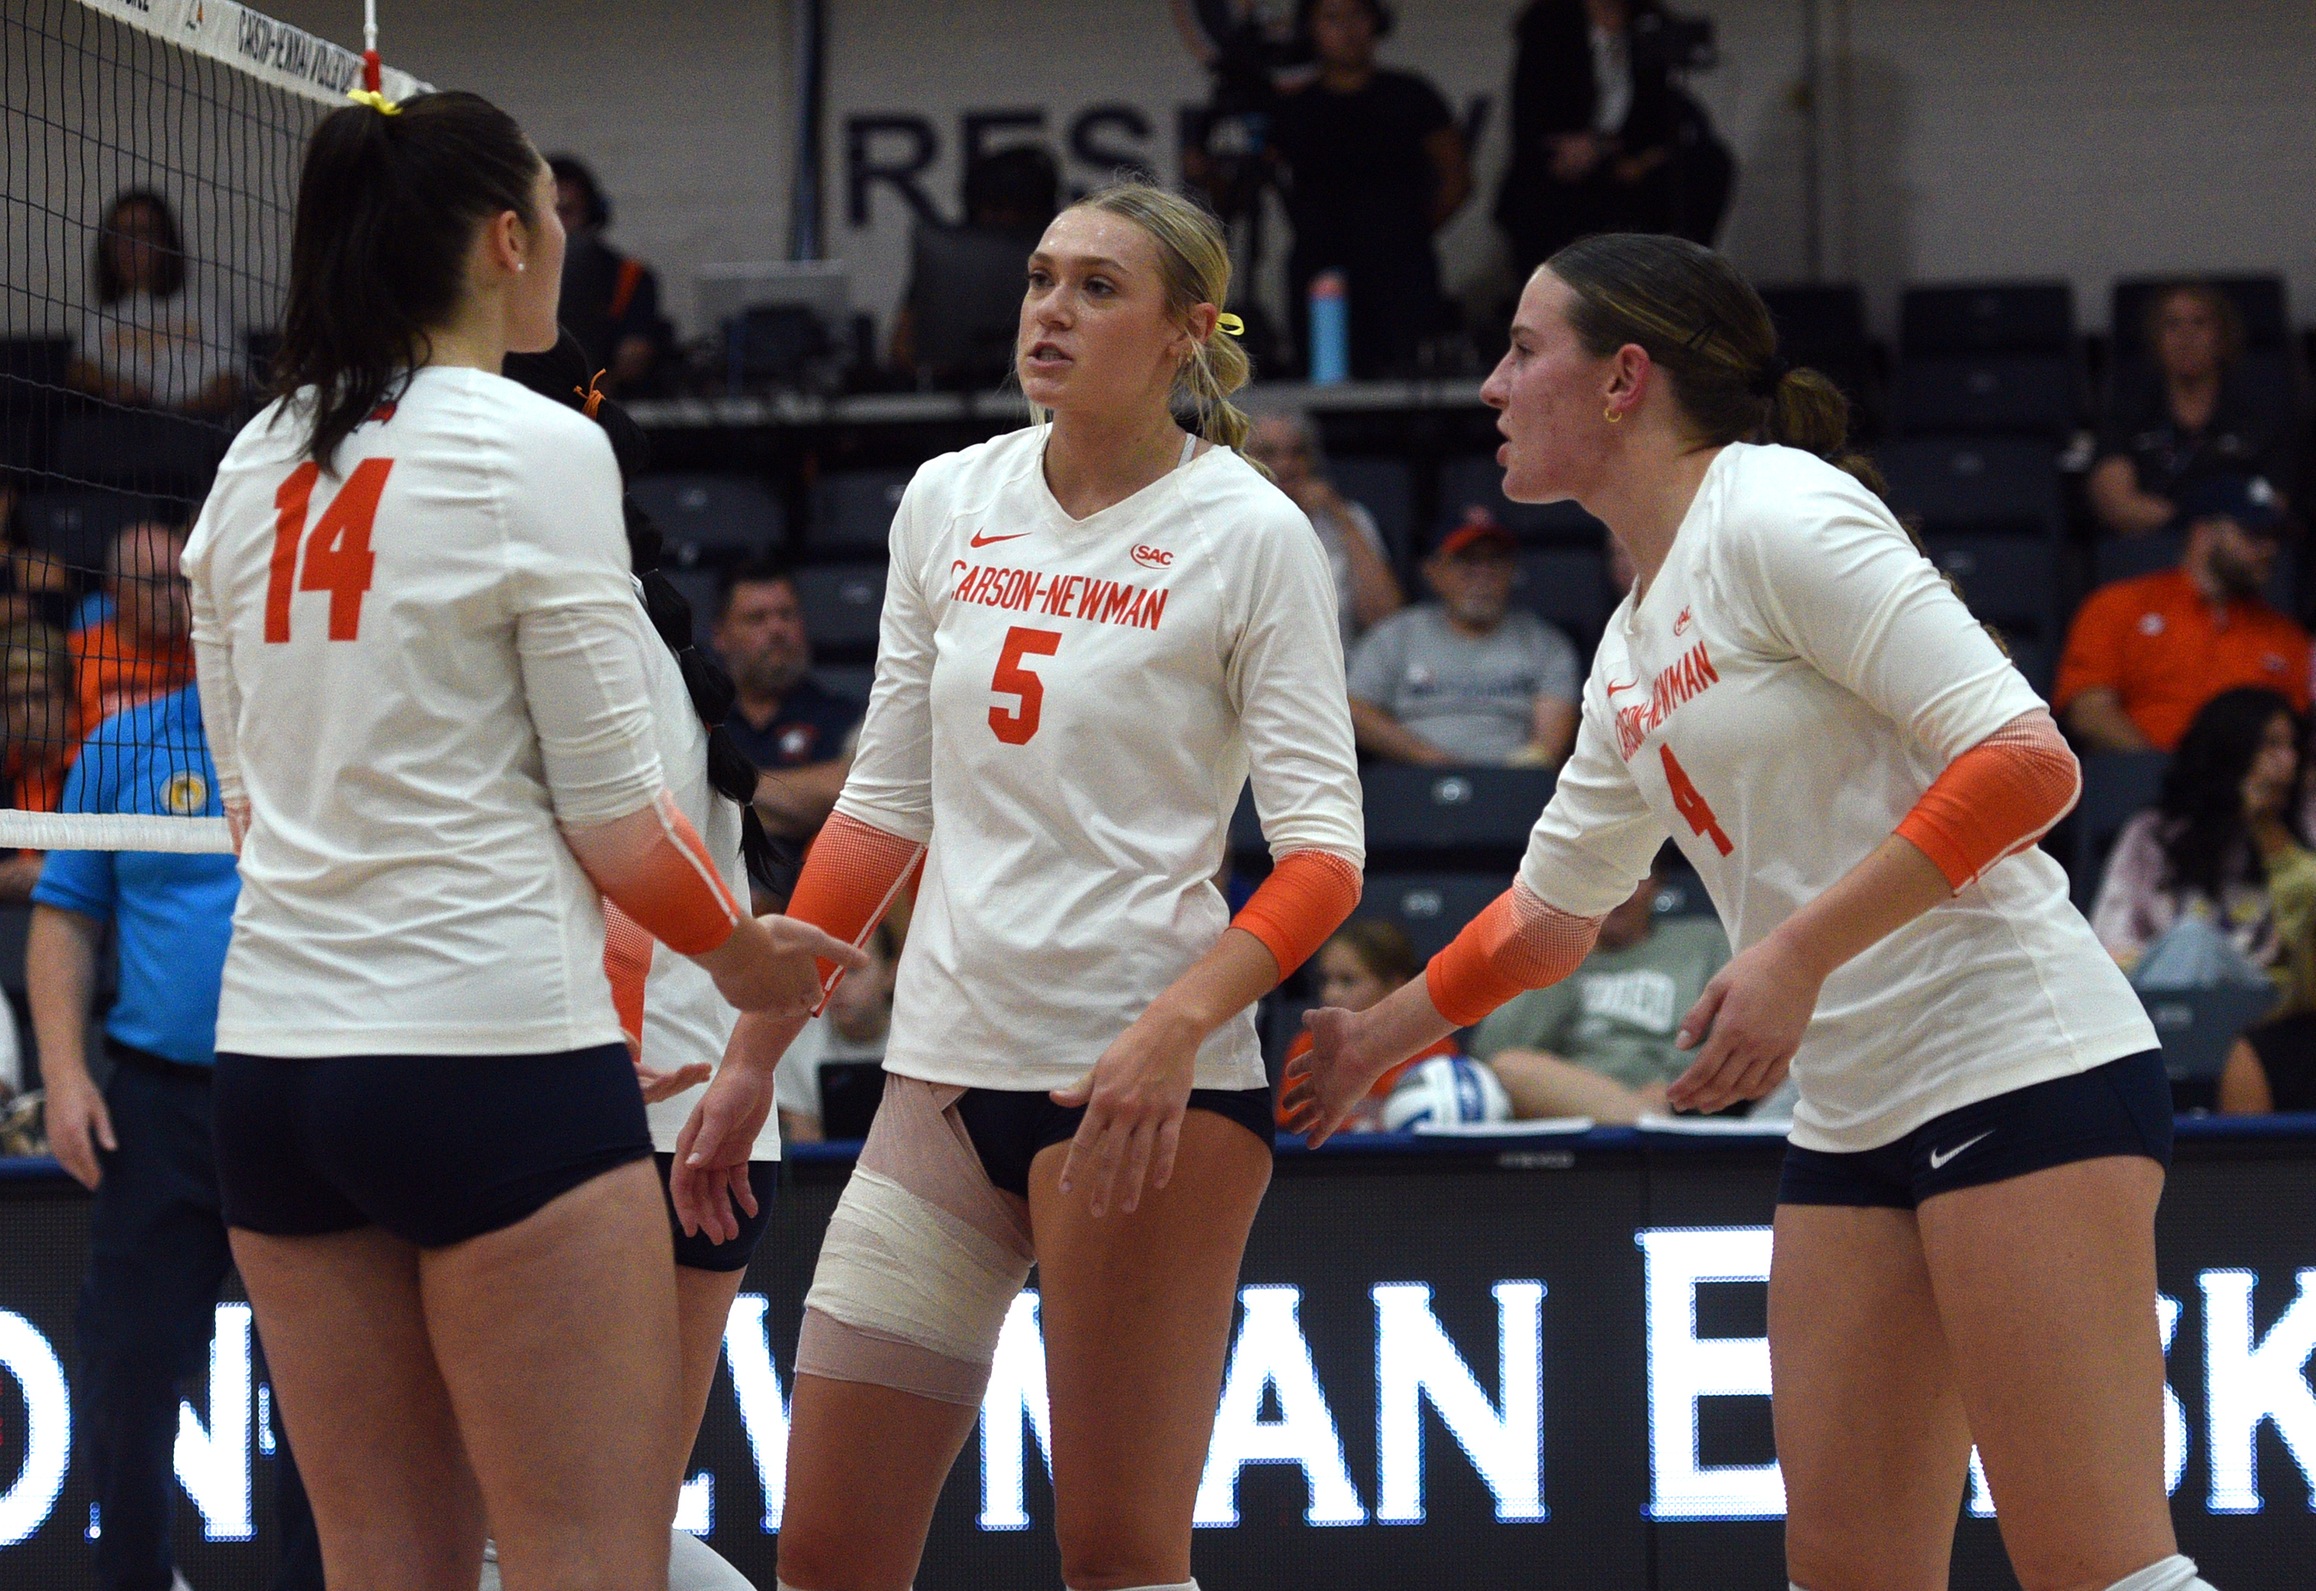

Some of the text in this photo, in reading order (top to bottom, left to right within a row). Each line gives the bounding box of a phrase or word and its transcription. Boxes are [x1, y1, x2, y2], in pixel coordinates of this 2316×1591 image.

[263, 457, 395, 643] 14
[950, 559, 1169, 631] CARSON-NEWMAN
[1135, 545, 1174, 566] SAC
[987, 626, 1062, 746] 5
[1659, 742, 1735, 858] 4
